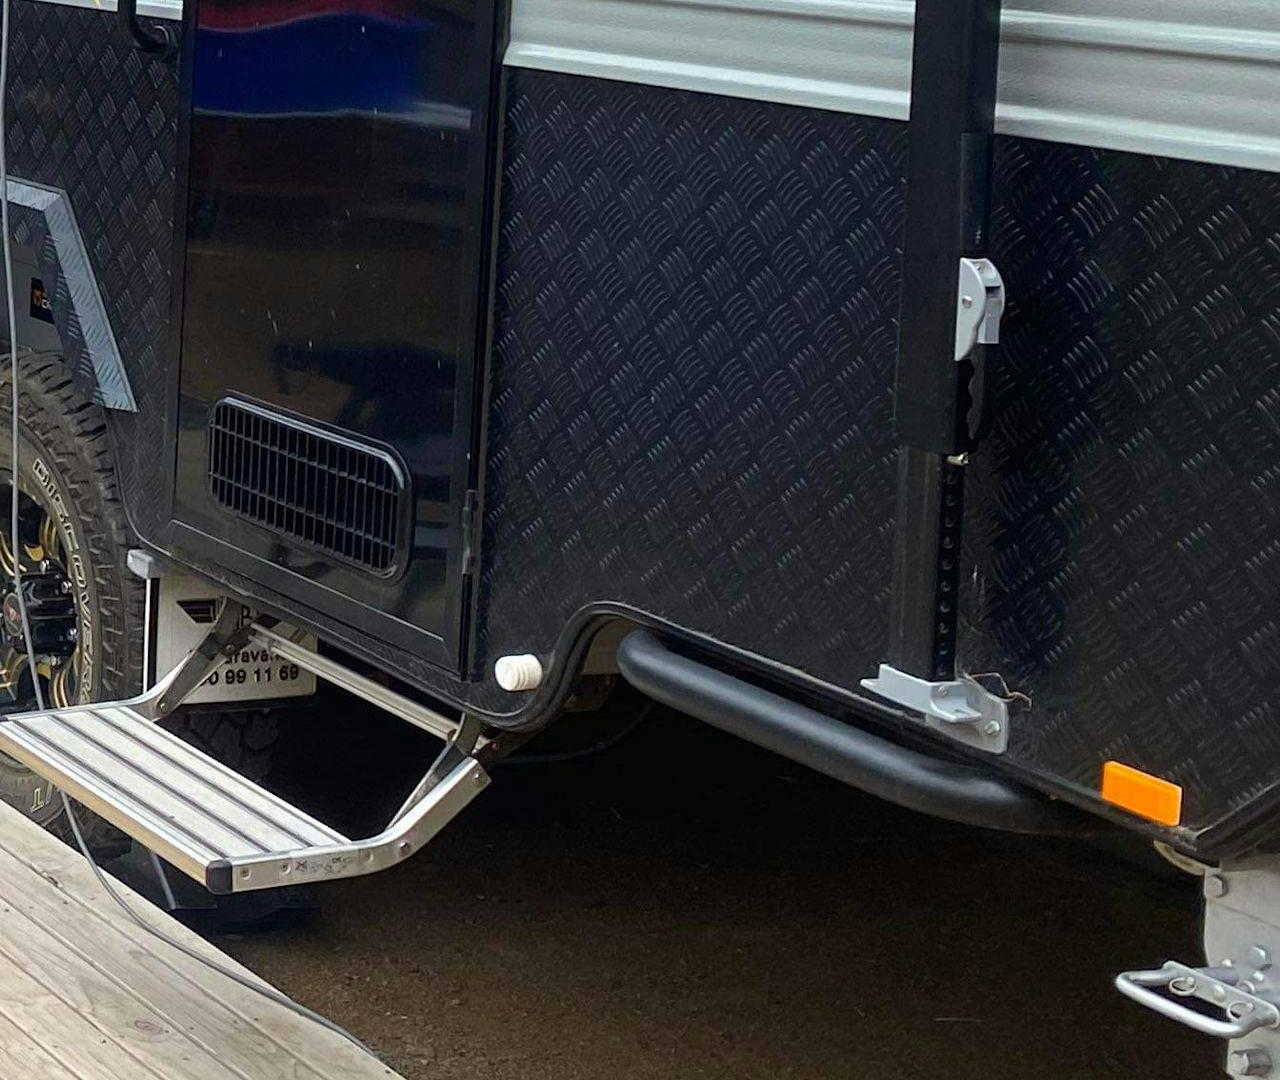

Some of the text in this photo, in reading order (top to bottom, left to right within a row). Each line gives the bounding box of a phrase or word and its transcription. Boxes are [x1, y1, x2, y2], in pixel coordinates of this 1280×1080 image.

[225, 669, 247, 684] 99
[254, 667, 271, 682] 11
[279, 665, 300, 681] 69
